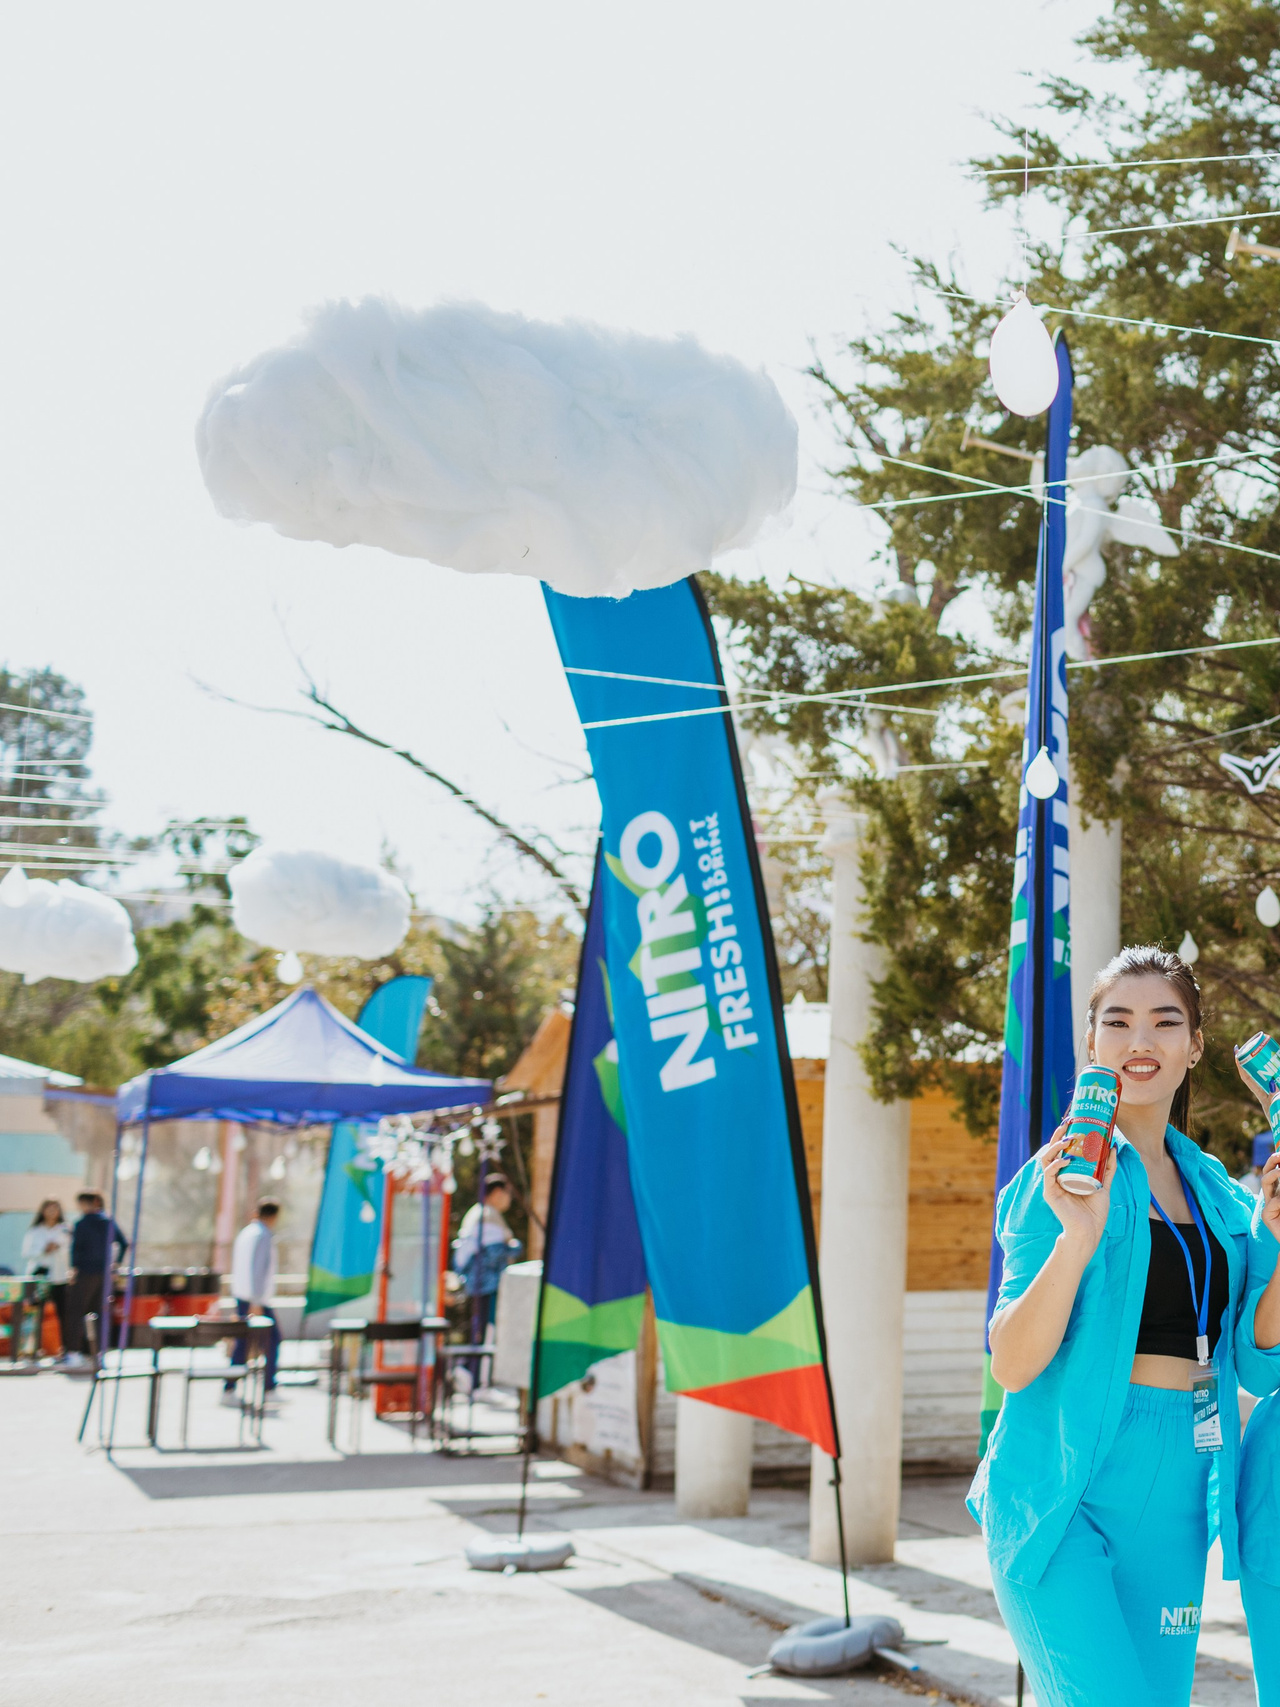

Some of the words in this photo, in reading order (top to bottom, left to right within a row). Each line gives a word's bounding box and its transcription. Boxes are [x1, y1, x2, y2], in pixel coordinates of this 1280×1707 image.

[619, 810, 717, 1093] NITRO
[703, 887, 759, 1051] FRESH!
[1161, 1606, 1201, 1626] NITR
